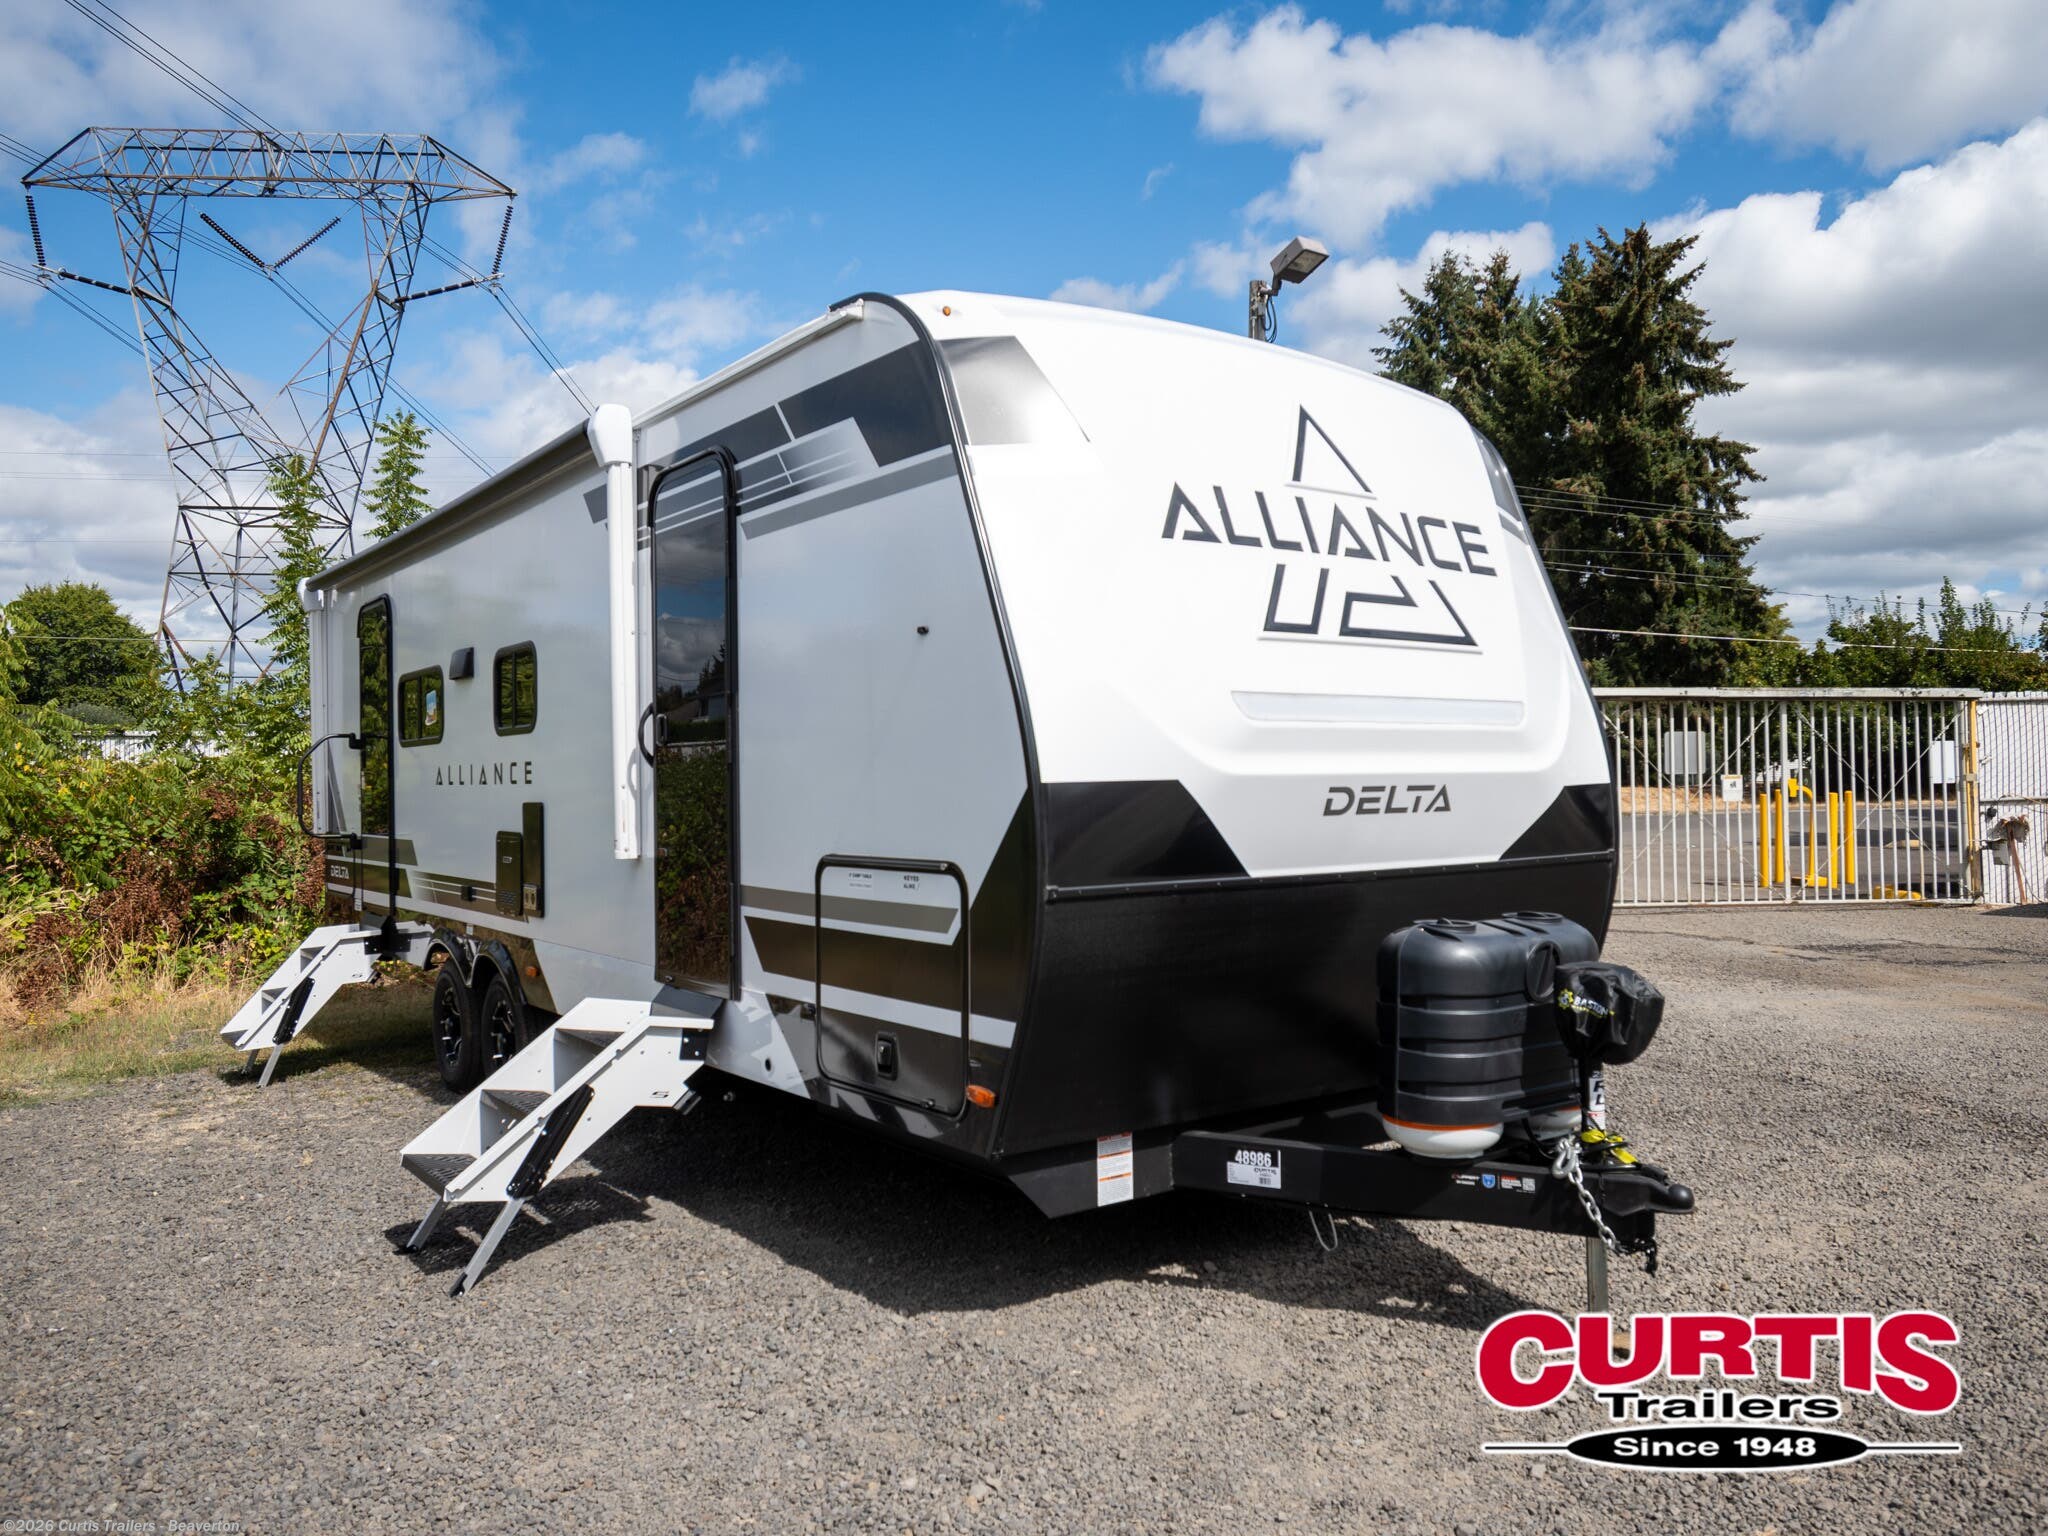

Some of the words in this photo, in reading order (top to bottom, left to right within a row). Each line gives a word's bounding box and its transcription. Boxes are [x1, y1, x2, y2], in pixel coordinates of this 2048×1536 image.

[1161, 481, 1497, 577] ALLIANCE
[435, 760, 532, 785] ALLIANCE
[1322, 784, 1451, 816] DELTA
[330, 865, 350, 879] DELTA
[1235, 1149, 1272, 1168] 48986
